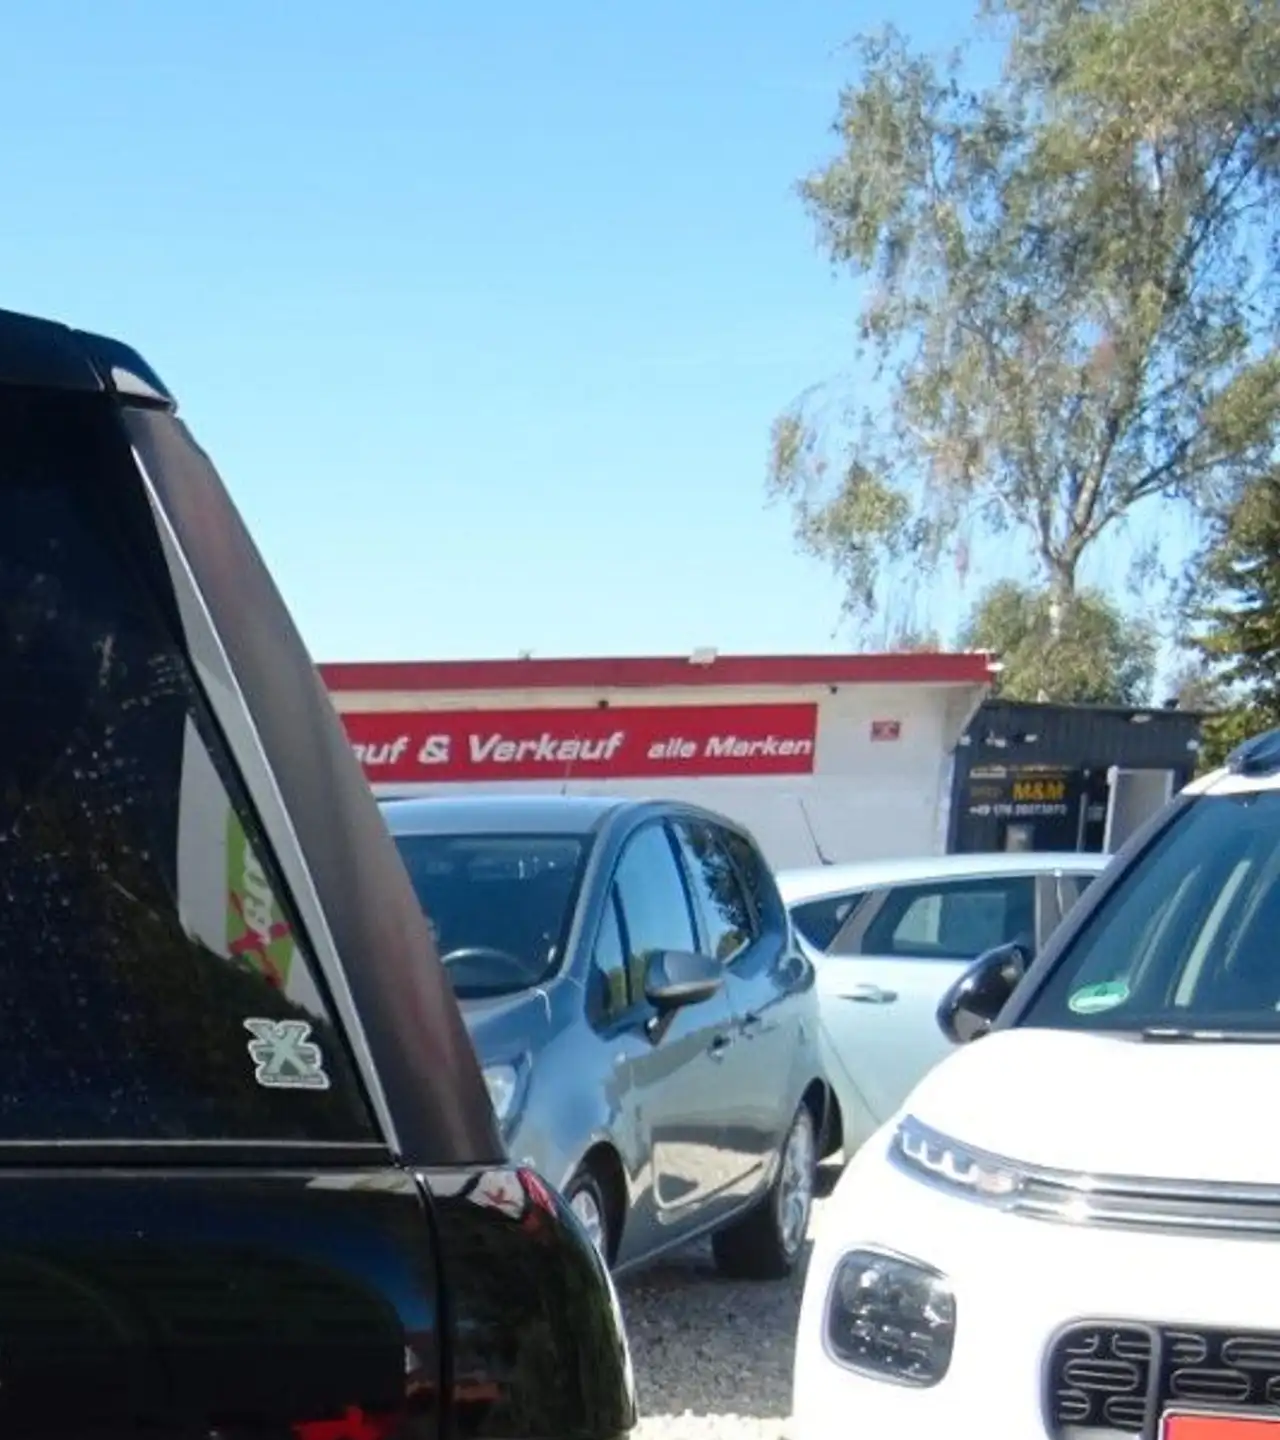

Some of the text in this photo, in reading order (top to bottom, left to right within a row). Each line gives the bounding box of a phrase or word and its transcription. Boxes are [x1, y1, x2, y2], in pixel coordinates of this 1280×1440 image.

[417, 734, 452, 764] &
[469, 731, 624, 763] Verkauf
[647, 737, 696, 759] alle
[704, 734, 812, 758] Marken
